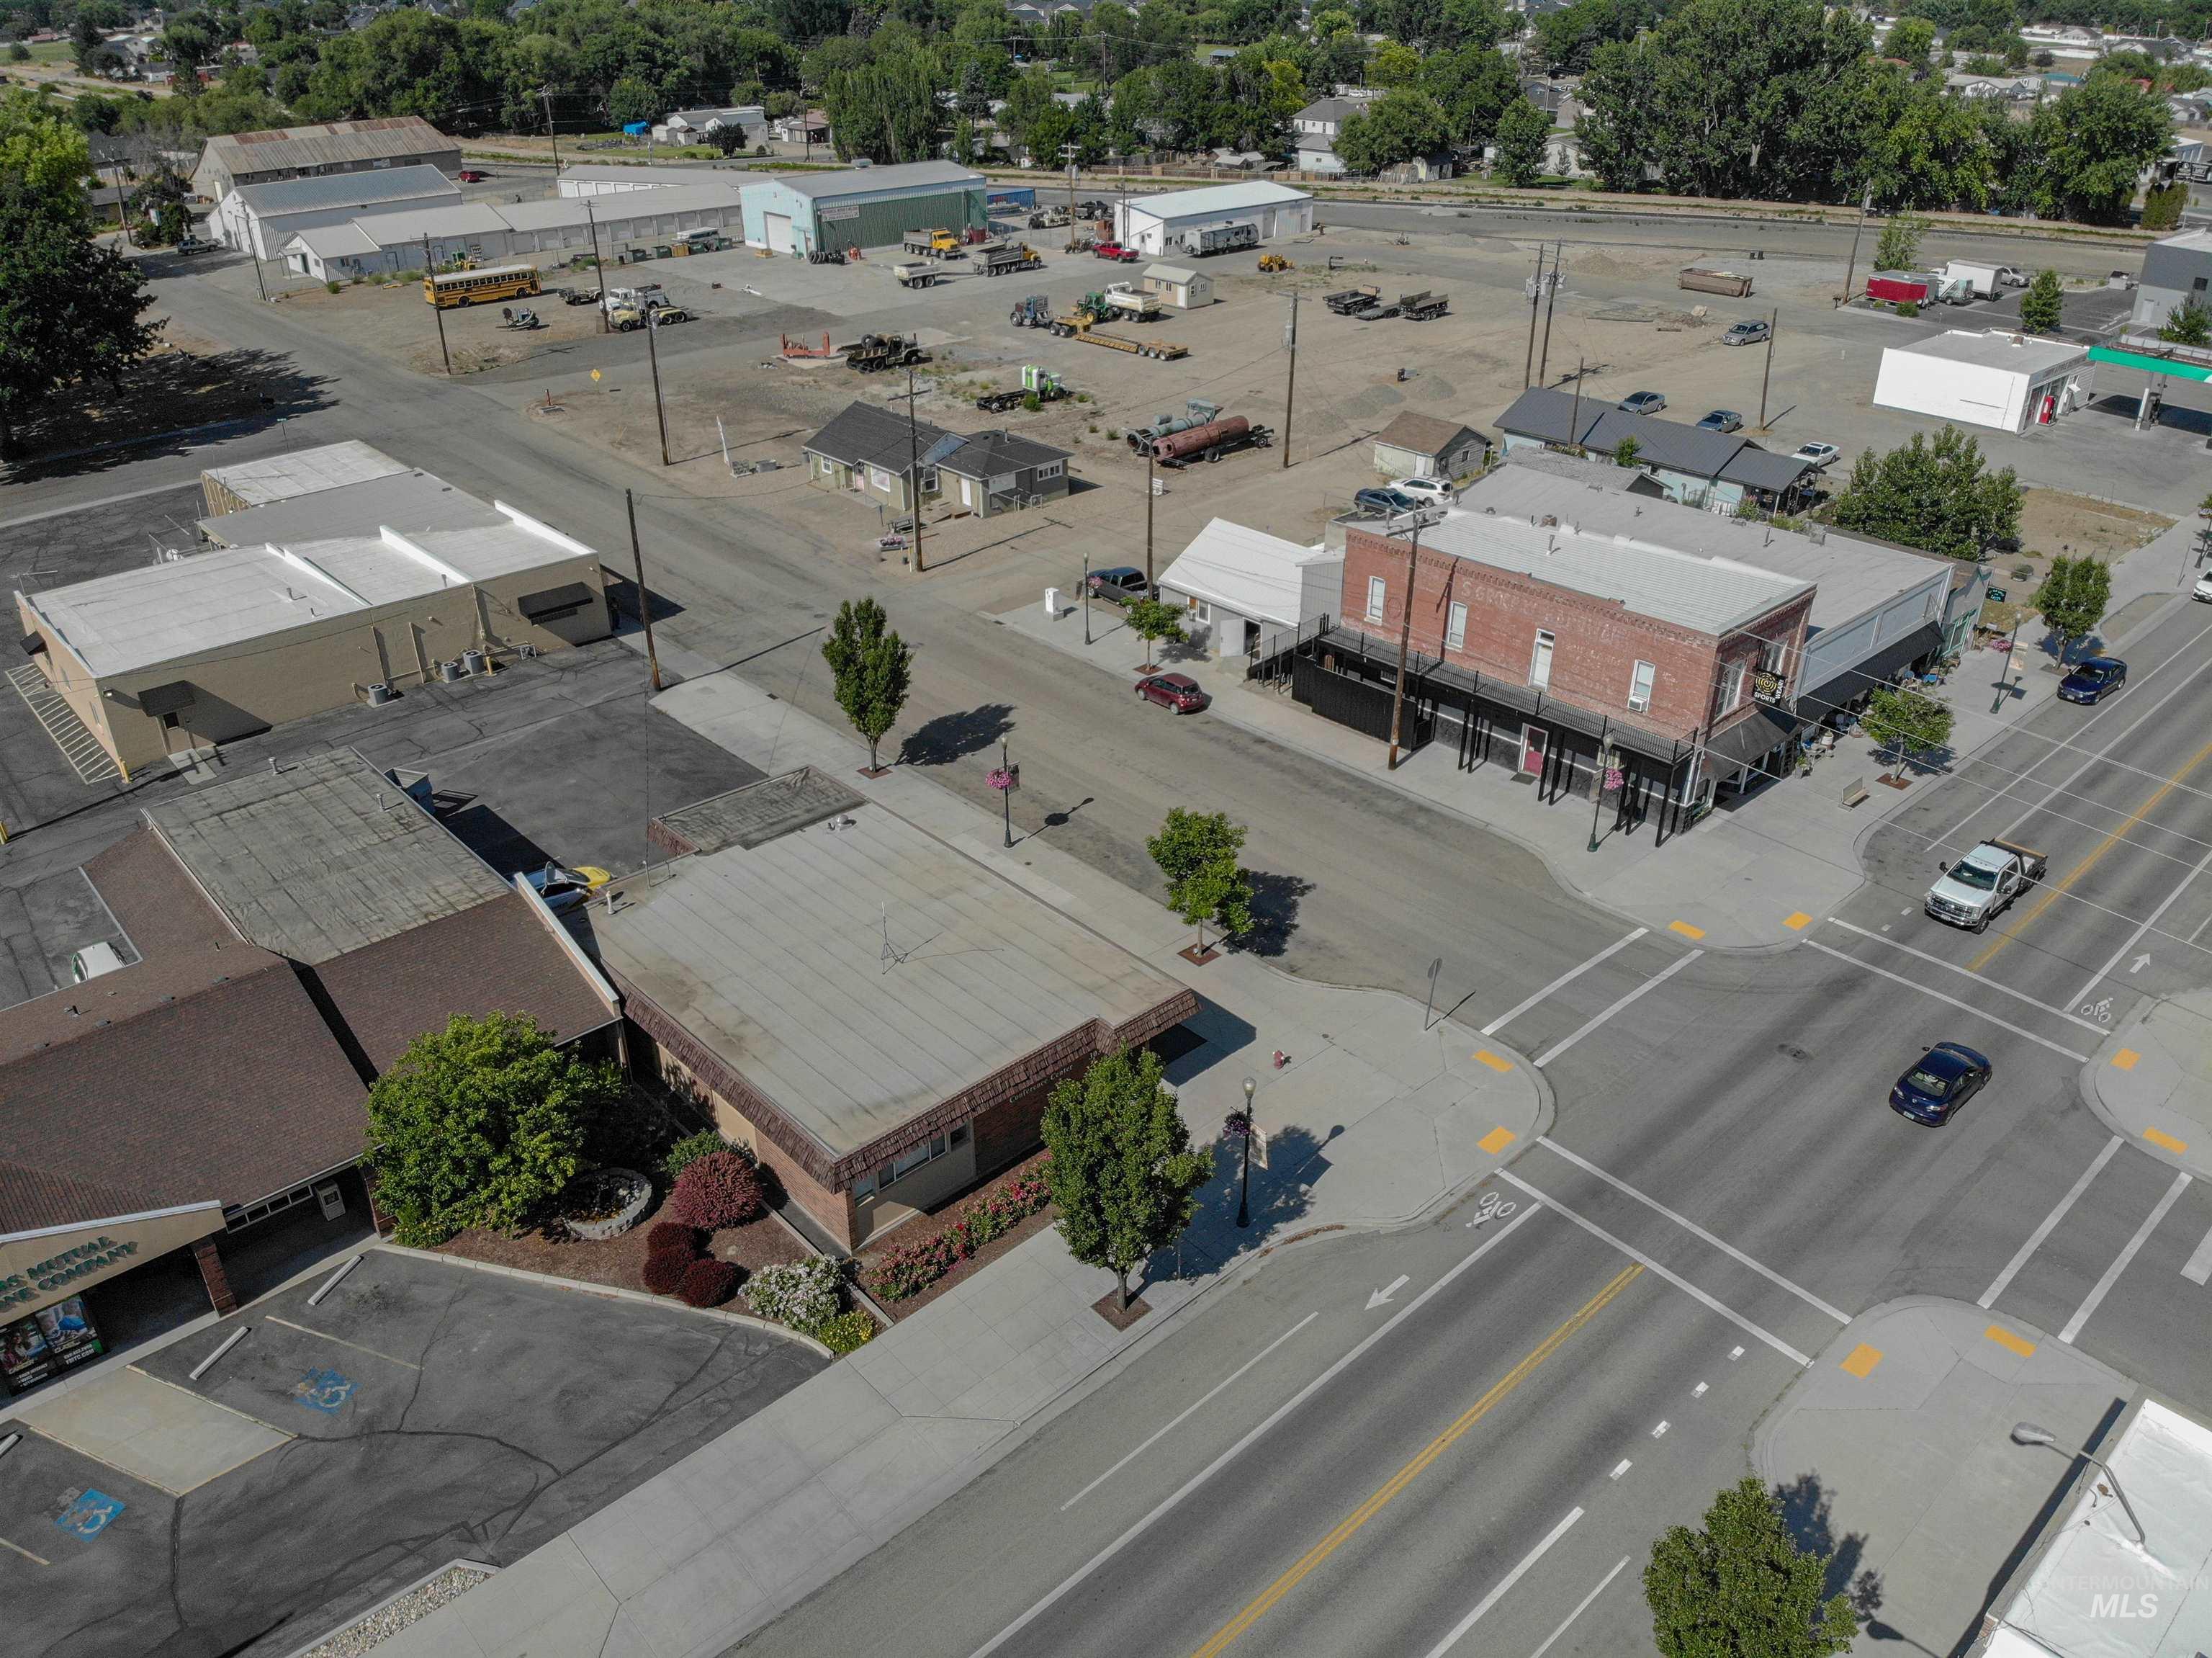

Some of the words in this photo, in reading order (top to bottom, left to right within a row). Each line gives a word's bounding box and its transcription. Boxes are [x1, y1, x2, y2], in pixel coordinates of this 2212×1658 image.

[1754, 692, 1776, 704] SPORTS
[1009, 1077, 1052, 1103] Conference
[1051, 1065, 1073, 1080] Center
[27, 1236, 109, 1279] MUTUAL
[37, 1241, 138, 1291] COMPANY
